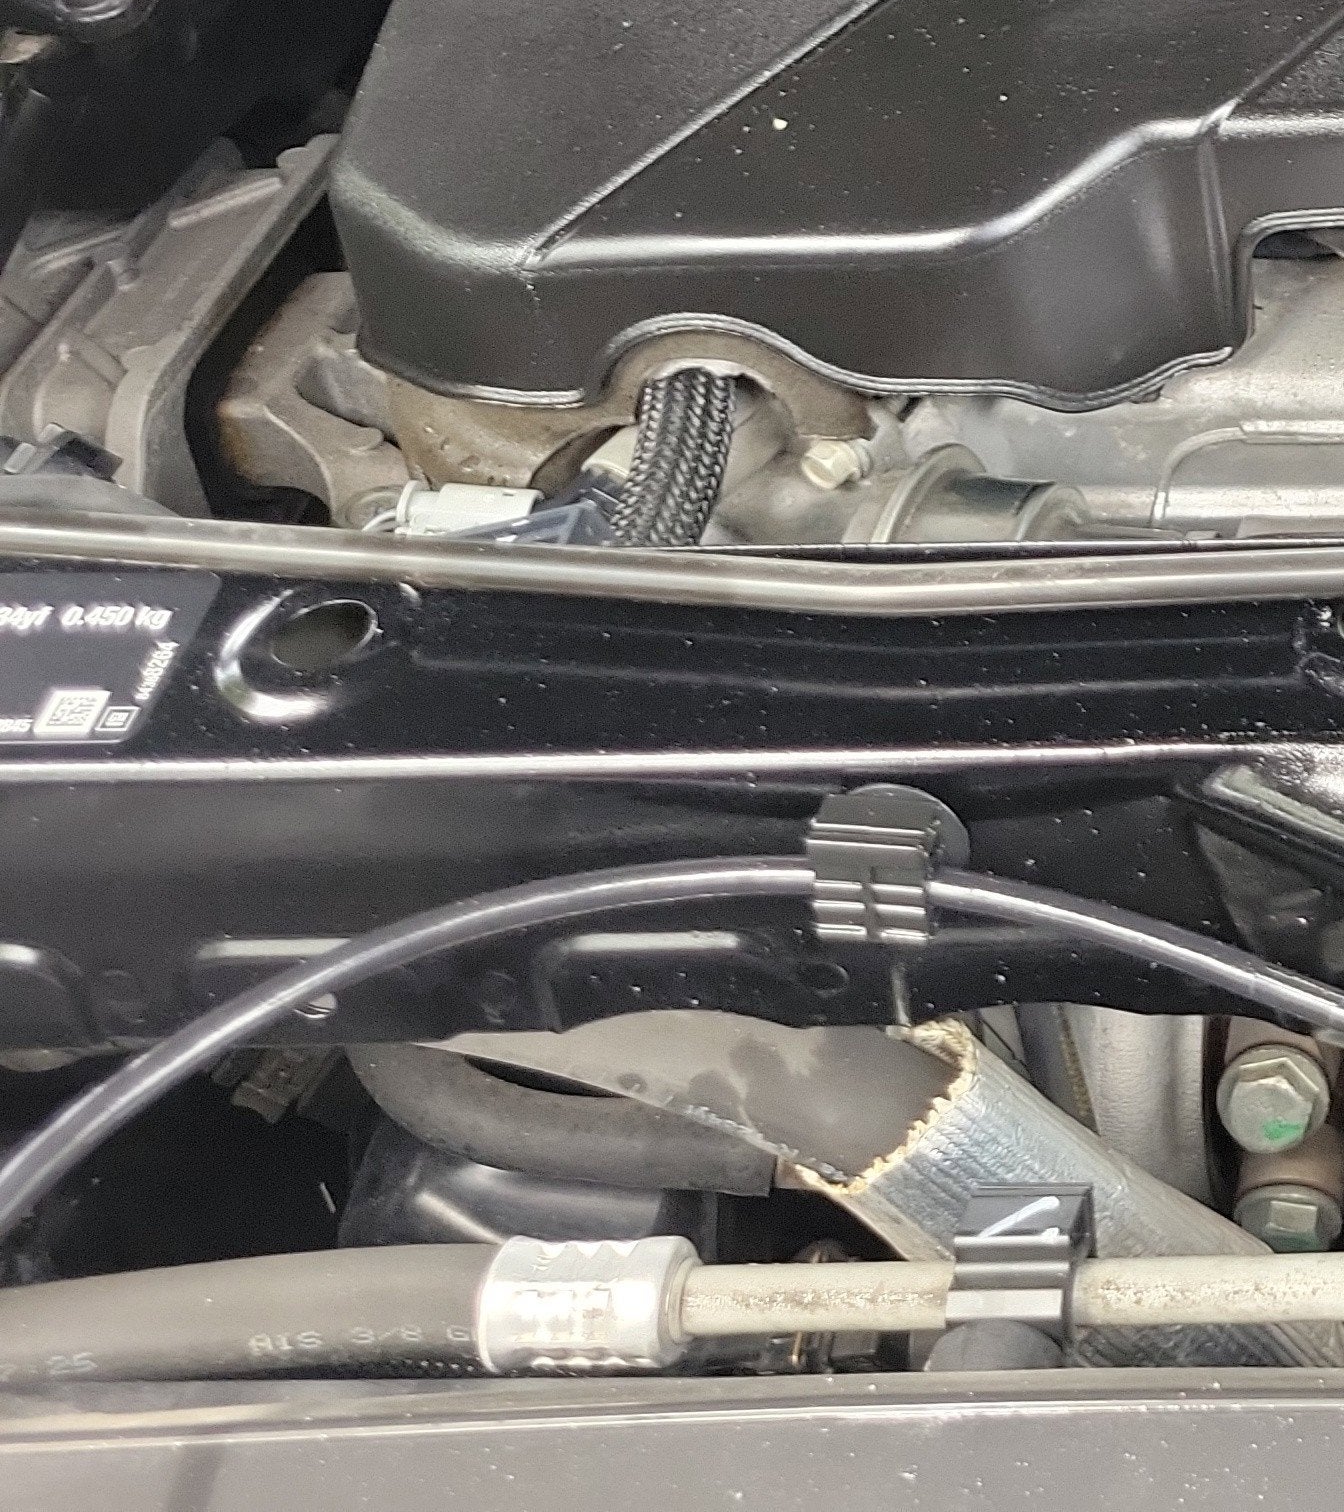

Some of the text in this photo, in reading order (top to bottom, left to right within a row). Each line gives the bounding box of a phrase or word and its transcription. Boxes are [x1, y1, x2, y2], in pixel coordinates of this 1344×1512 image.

[61, 604, 135, 627] 0.450
[135, 605, 174, 630] kg
[350, 1324, 423, 1345] 3/8
